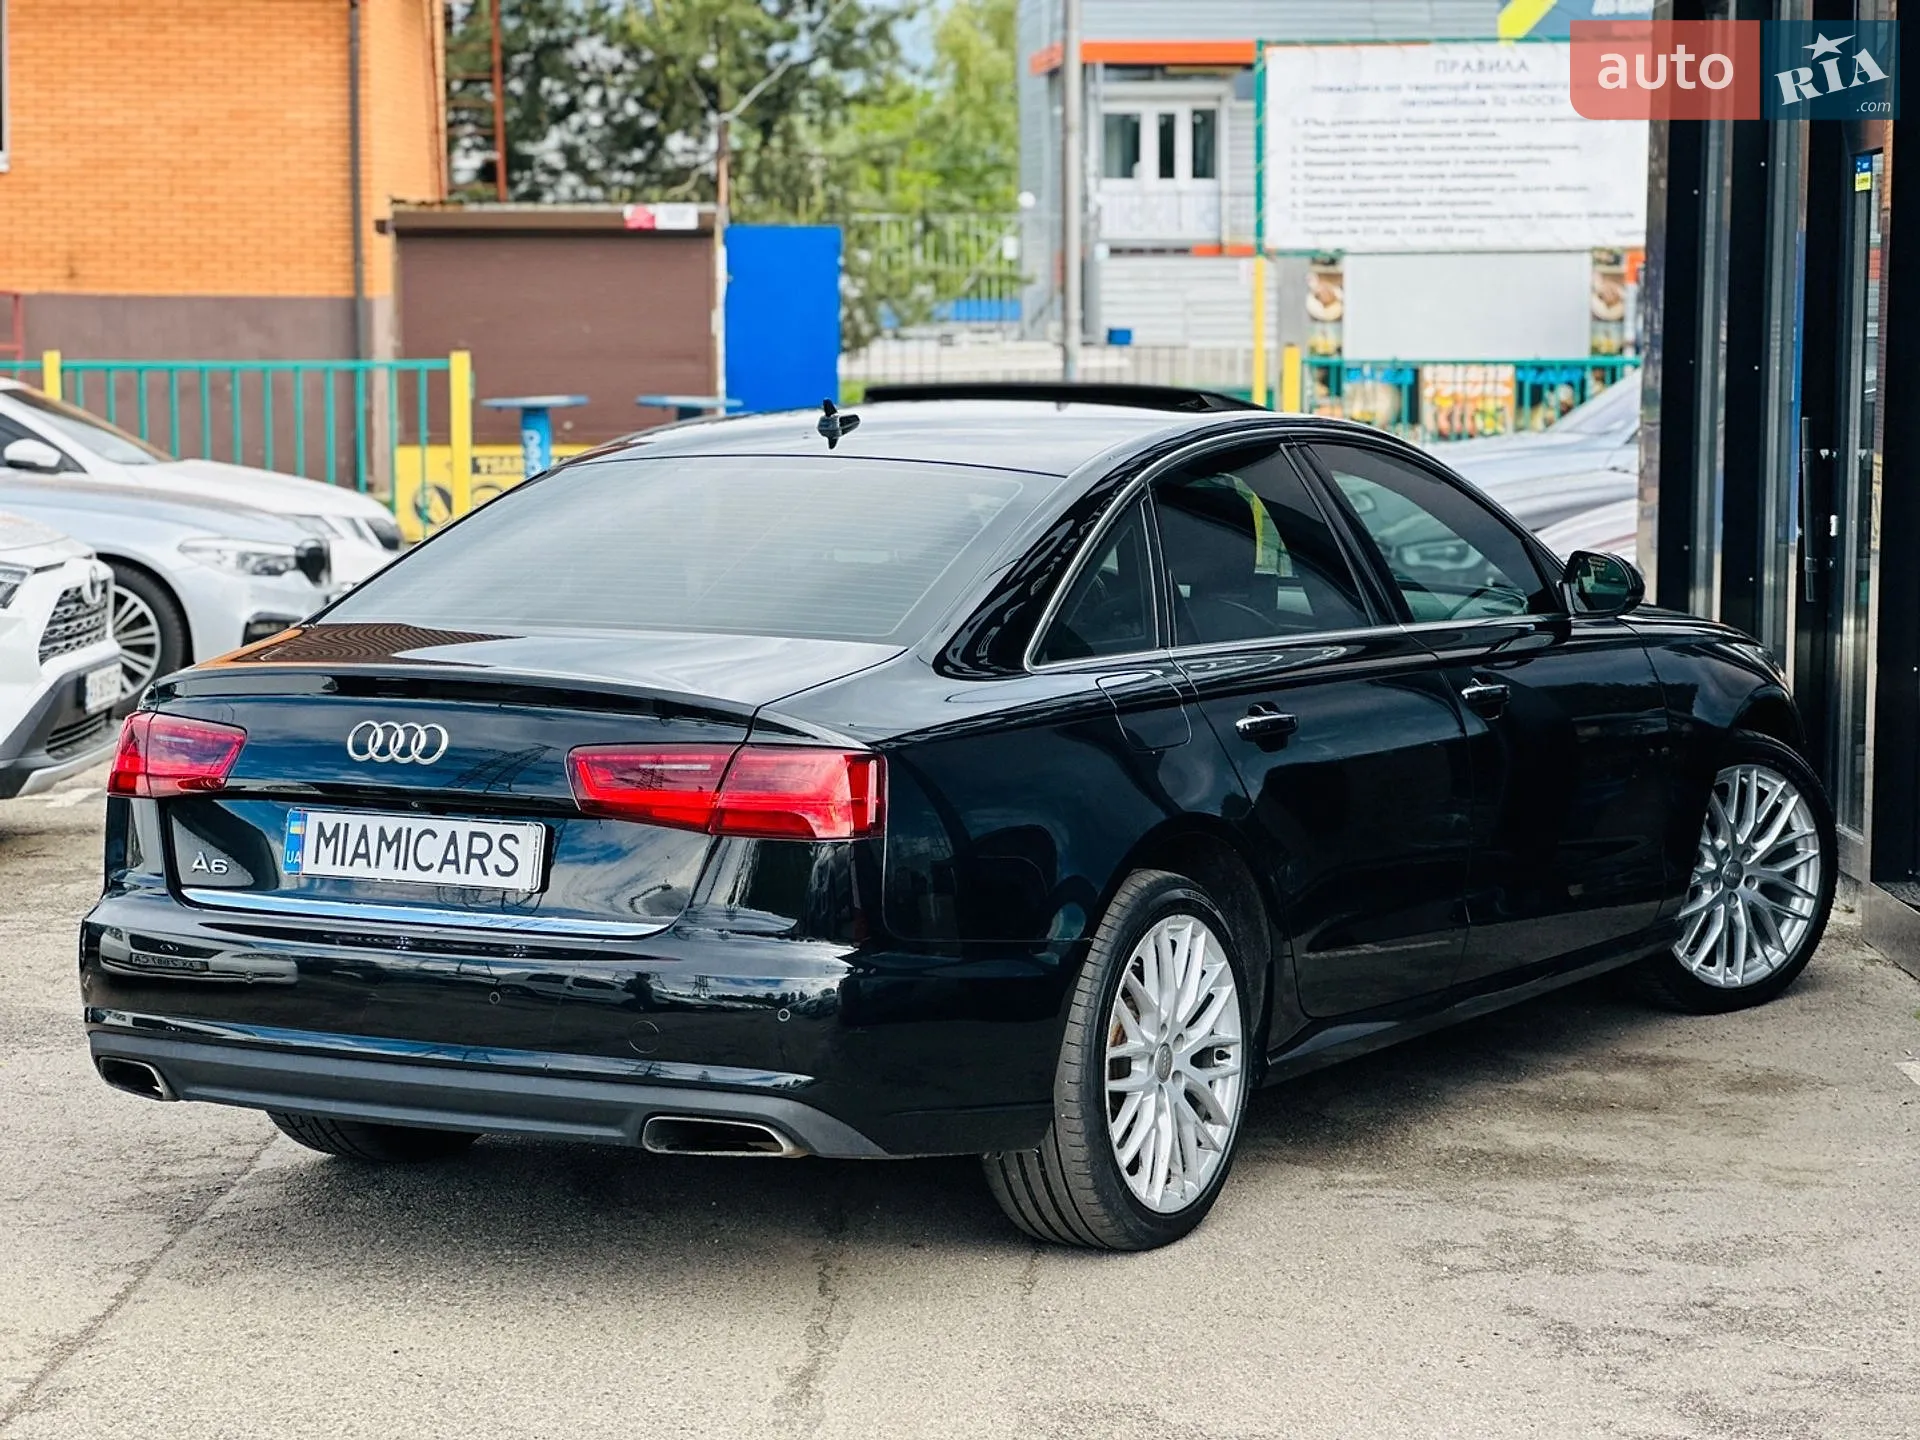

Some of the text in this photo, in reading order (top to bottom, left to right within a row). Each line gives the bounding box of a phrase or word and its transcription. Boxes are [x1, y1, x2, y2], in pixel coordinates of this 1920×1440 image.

[1434, 59, 1530, 74] ПРАВИЛА
[285, 820, 521, 878] UA MIAMICARS
[191, 851, 229, 874] A6
